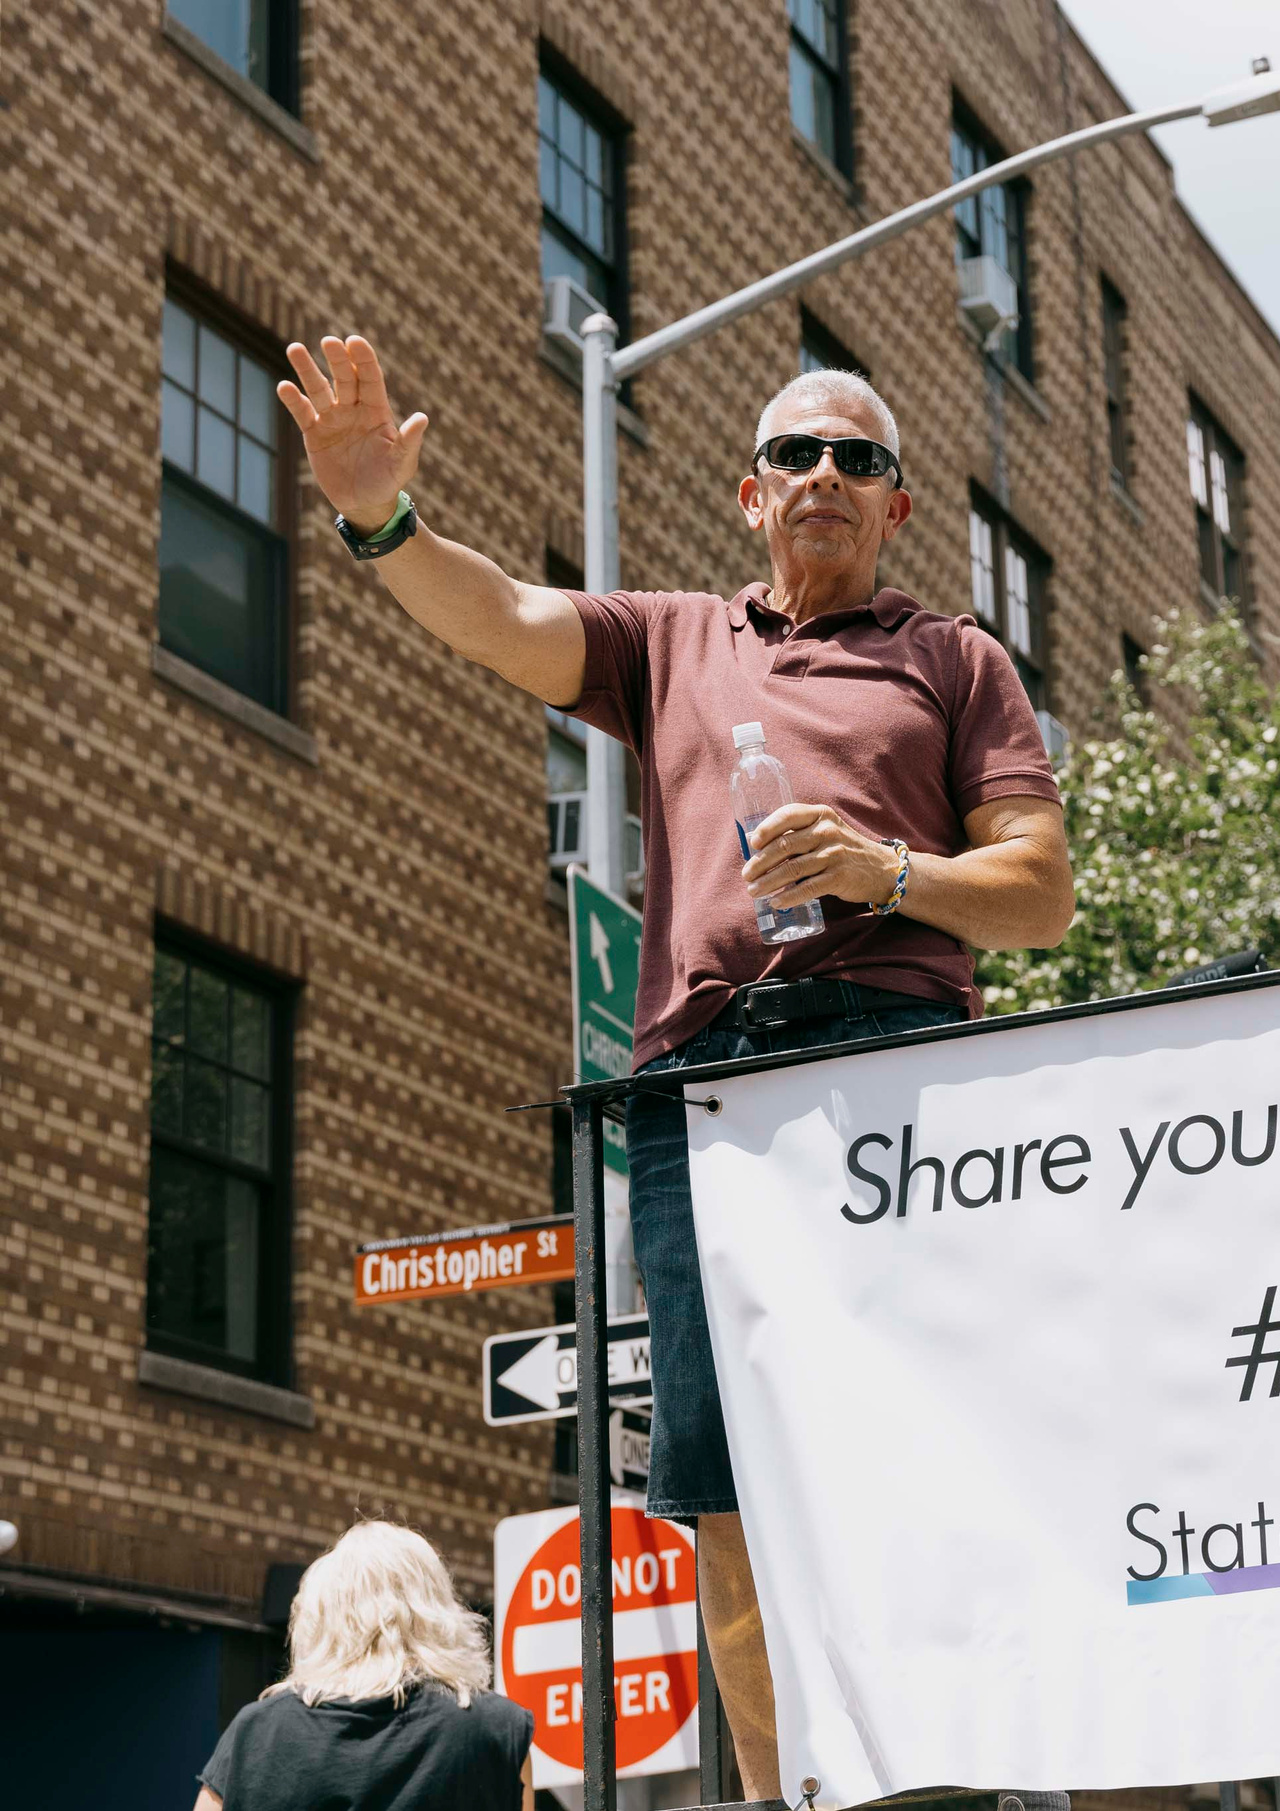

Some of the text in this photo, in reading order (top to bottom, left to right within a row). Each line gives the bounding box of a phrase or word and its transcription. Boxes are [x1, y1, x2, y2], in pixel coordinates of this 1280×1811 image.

[840, 1124, 1091, 1226] Share
[363, 1240, 527, 1295] Christopher
[537, 1230, 558, 1258] St
[557, 1348, 615, 1385] OE
[531, 1547, 682, 1611] DO NOT
[546, 1670, 671, 1727] EER
